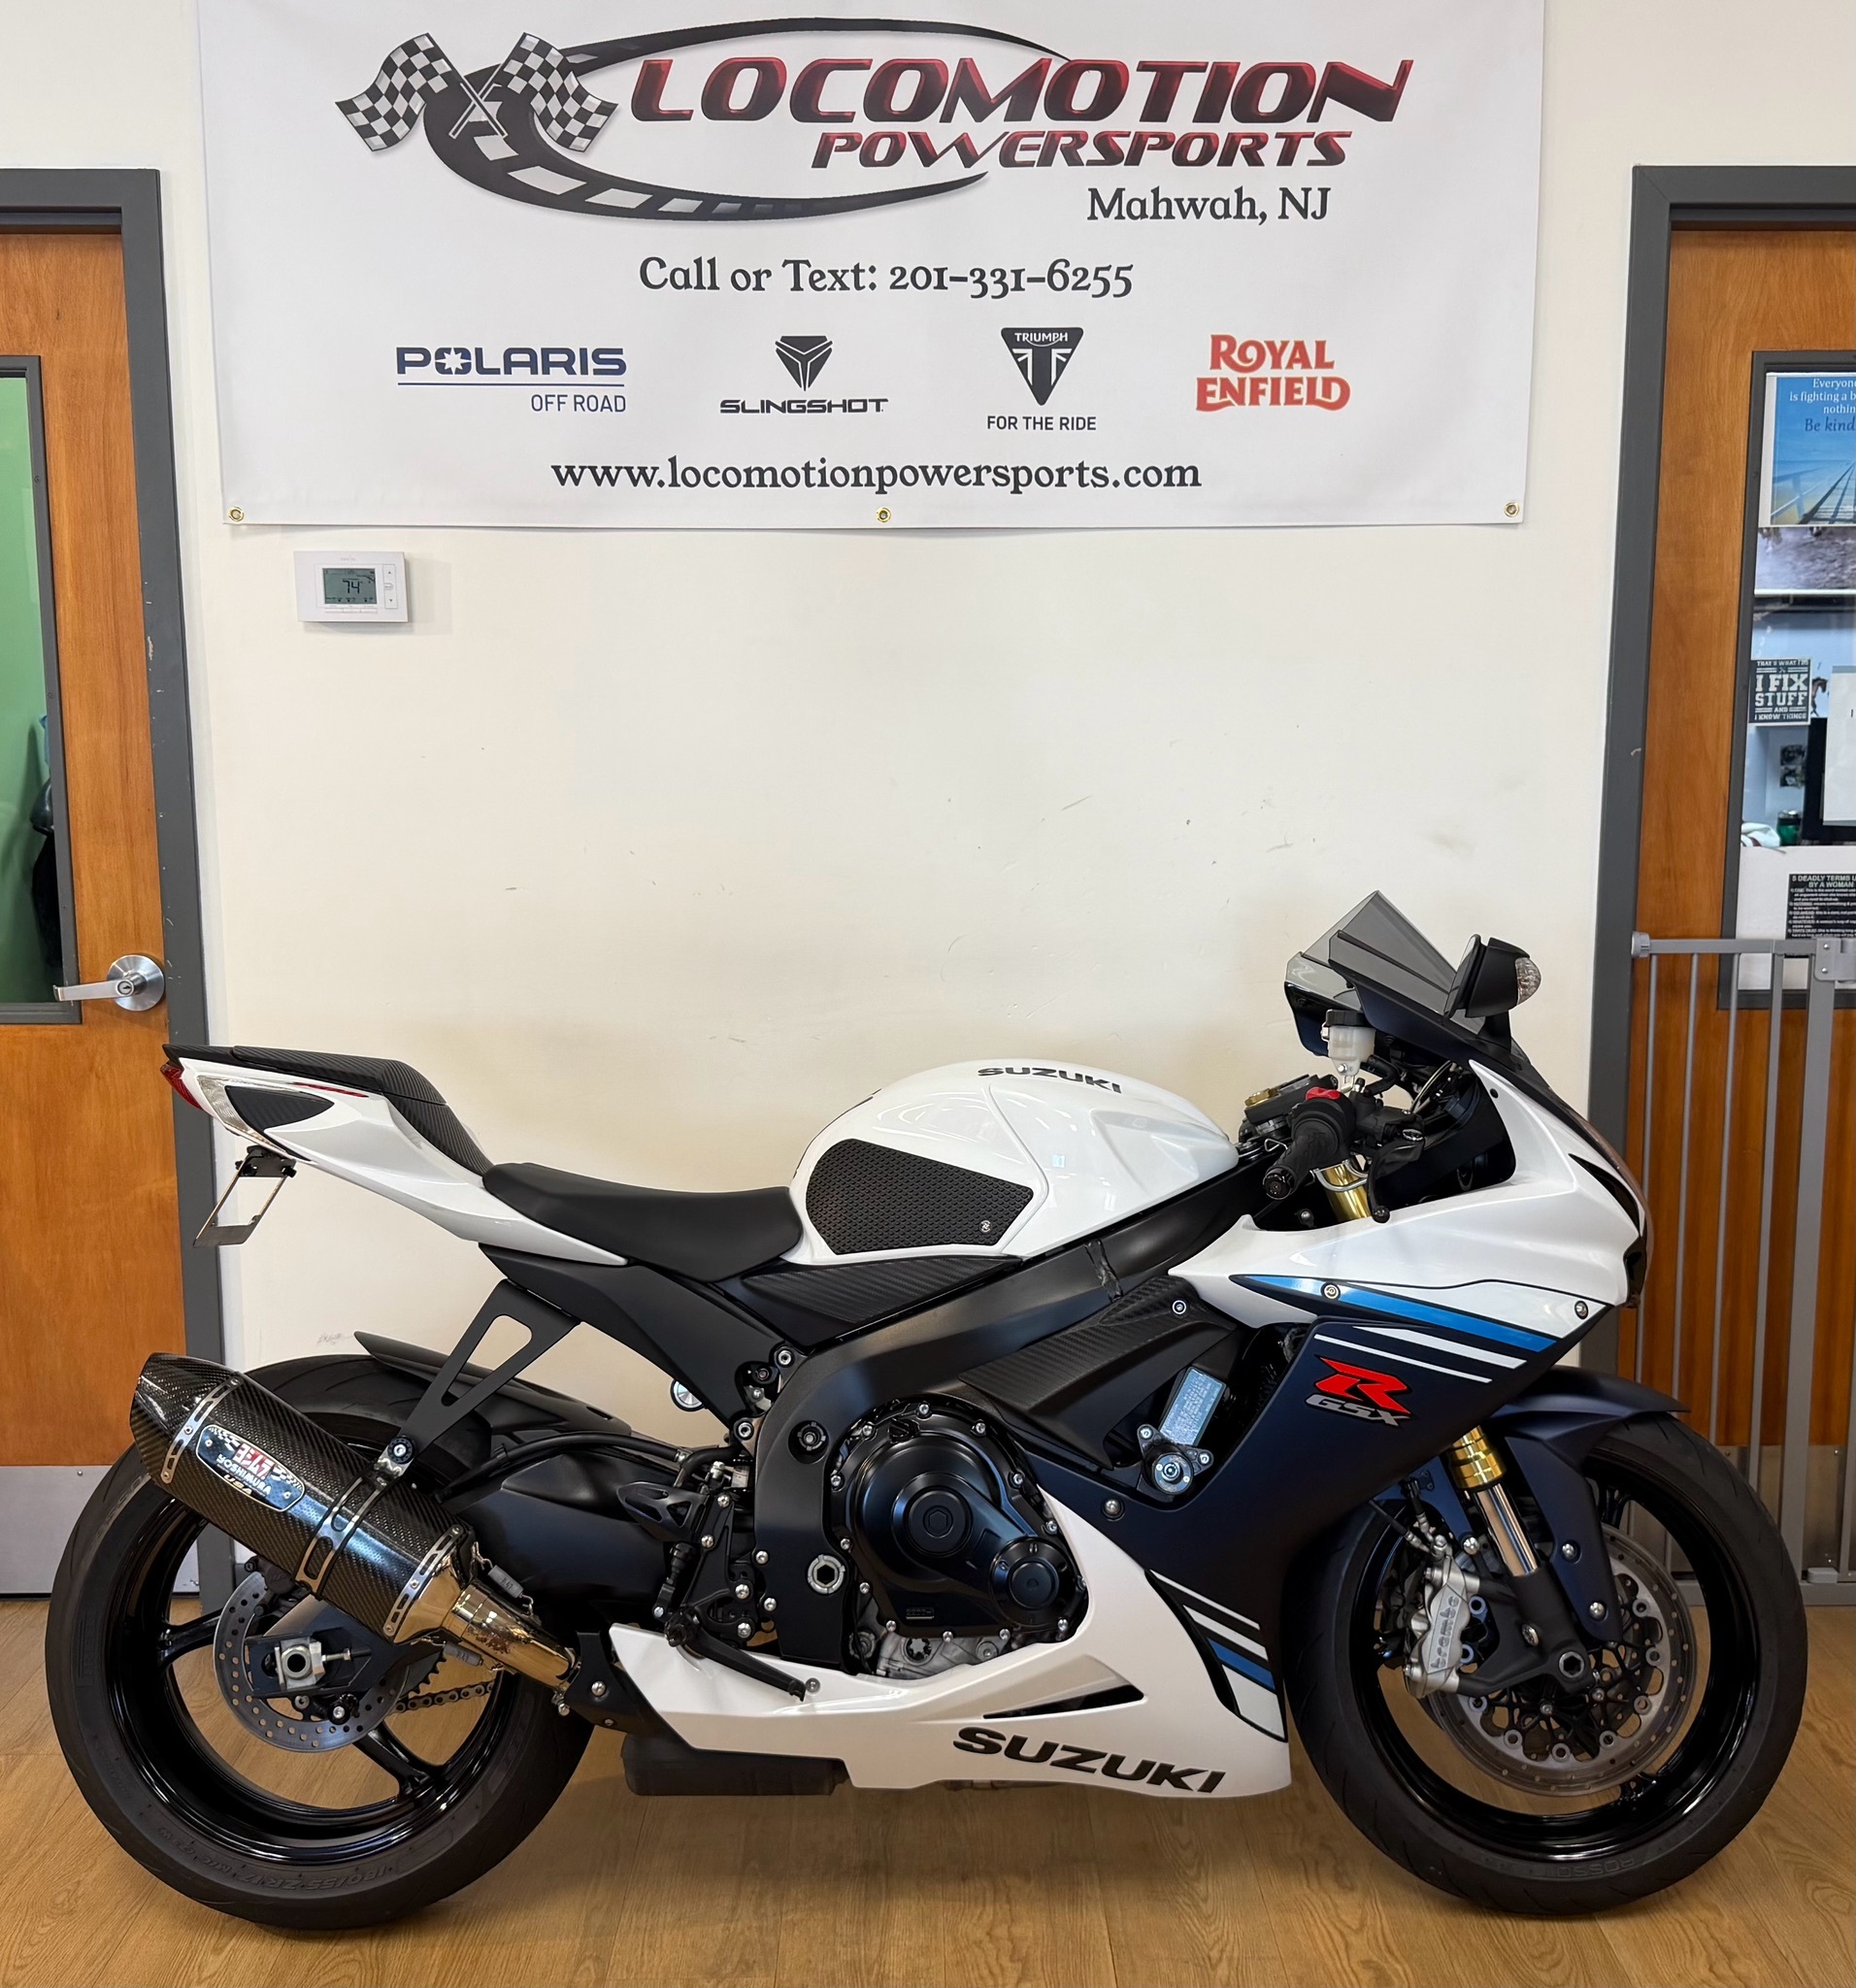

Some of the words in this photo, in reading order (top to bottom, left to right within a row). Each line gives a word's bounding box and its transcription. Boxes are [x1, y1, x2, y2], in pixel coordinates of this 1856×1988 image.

[630, 56, 1414, 123] LOCOMOTION
[811, 130, 1353, 170] POWERSPORTS
[1086, 187, 1269, 226] Mahwah,
[1277, 186, 1332, 221] NJ
[639, 256, 720, 291] Call
[730, 265, 773, 292] or
[781, 258, 878, 292] Text:
[888, 257, 1135, 300] 201-331-6255
[1013, 332, 1069, 344] TRIUMPH
[1209, 334, 1336, 374] ROYAL
[396, 347, 627, 377] POLARIS
[530, 394, 568, 412] OFF
[573, 394, 627, 413] ROAD
[719, 398, 889, 414] SLINGSHOT
[1195, 376, 1351, 412] ENFIELD
[1801, 390, 1839, 404] fighting
[986, 415, 1018, 431] FOR
[1022, 415, 1054, 431] THE
[1059, 415, 1097, 431] RIDE
[1805, 417, 1821, 432] Be
[551, 456, 1202, 495] www.locomotionpowersports.com
[1755, 674, 1764, 692] I
[1768, 673, 1808, 692] FIX
[1754, 691, 1807, 707] STUFF
[978, 1067, 1122, 1094] SUZUKI
[1306, 1394, 1410, 1426] GSX
[216, 1453, 272, 1496] YOSHIMURA
[1430, 1595, 1460, 1669] brembo
[953, 1726, 1226, 1793] SUZUKI
